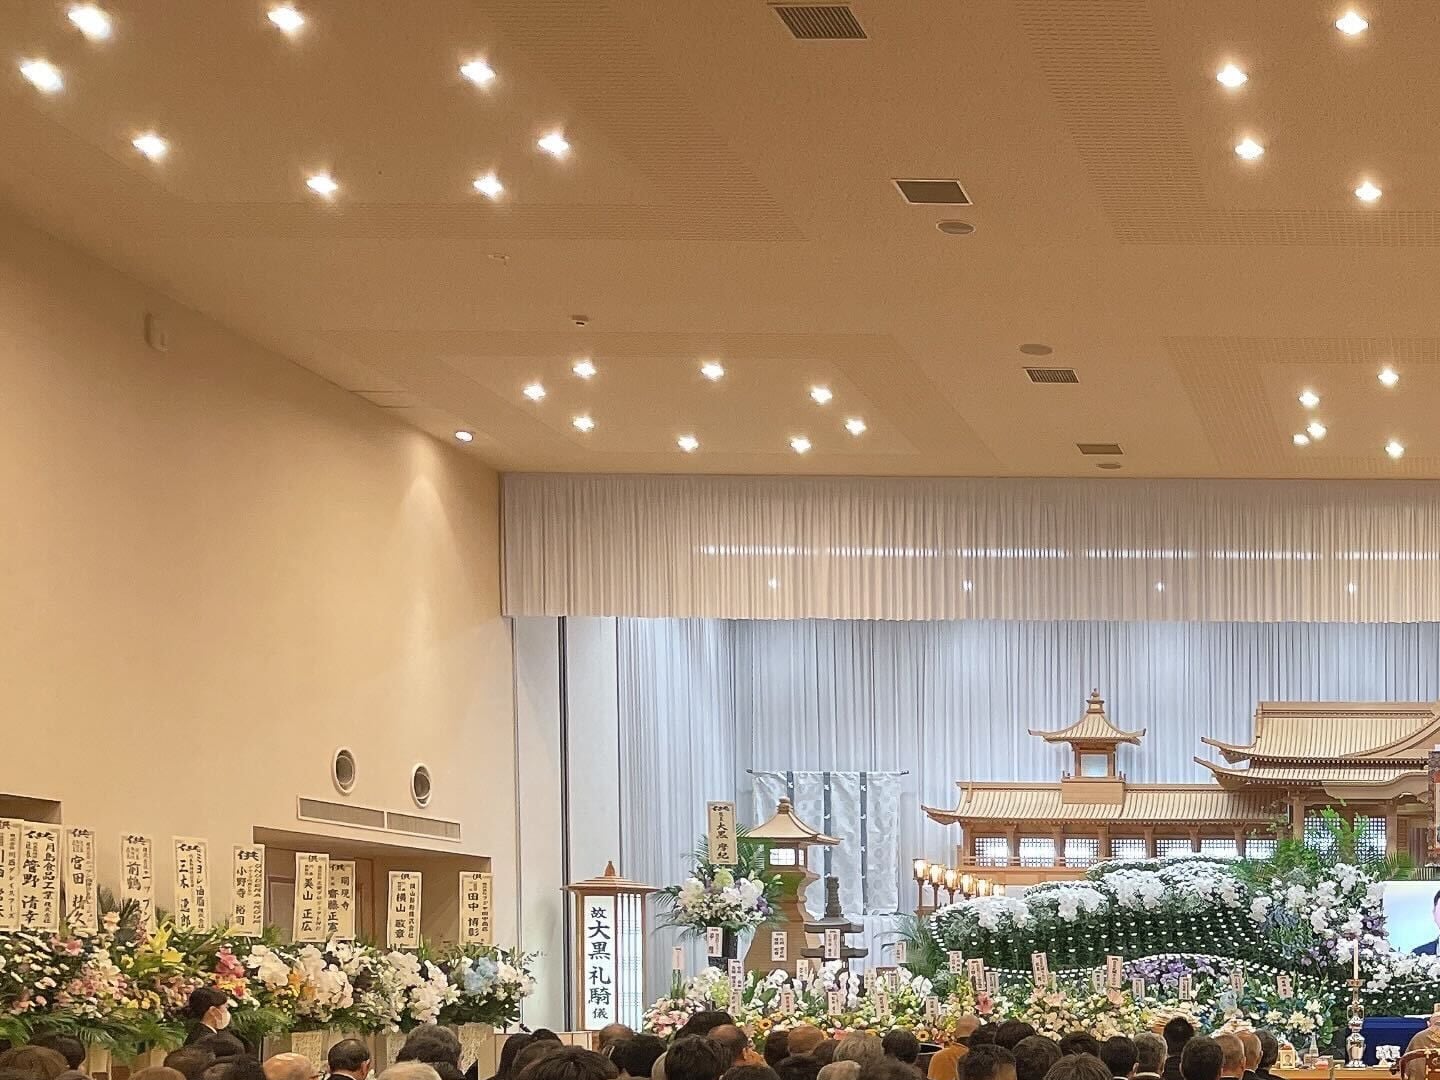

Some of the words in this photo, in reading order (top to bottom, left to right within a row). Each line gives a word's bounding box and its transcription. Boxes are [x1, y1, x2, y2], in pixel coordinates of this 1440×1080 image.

[588, 906, 611, 1020] 故大黒礼騎儀
